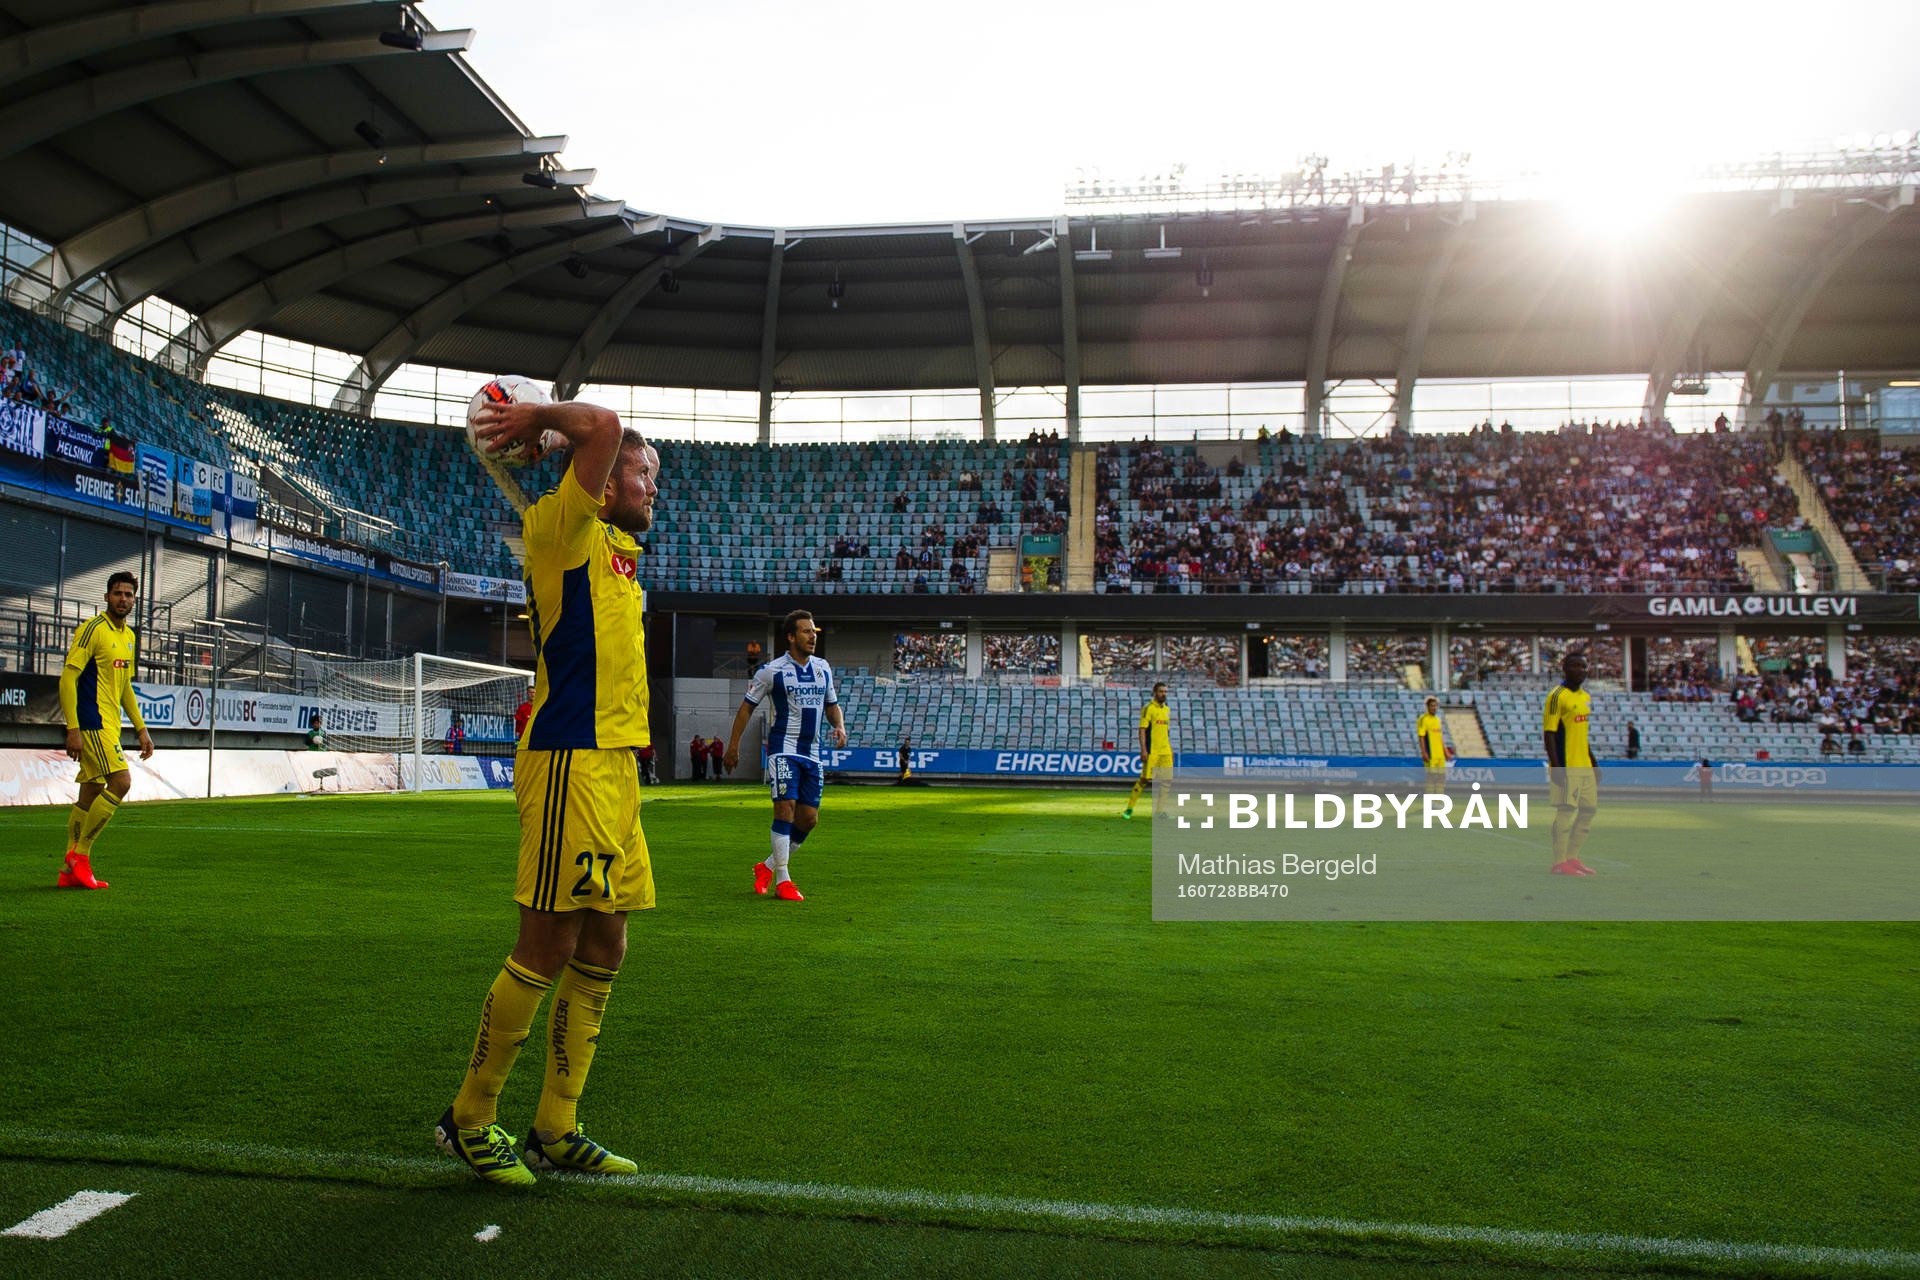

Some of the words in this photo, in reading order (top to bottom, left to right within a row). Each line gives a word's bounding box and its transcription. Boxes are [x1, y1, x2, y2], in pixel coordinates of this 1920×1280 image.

[57, 440, 93, 464] HELSINKI
[199, 467, 207, 485] C
[213, 472, 224, 491] FC
[75, 474, 115, 501] SVERIGE
[236, 480, 254, 499] HJK
[293, 538, 306, 553] oss
[306, 539, 321, 555] hela
[341, 549, 351, 563] till
[1648, 597, 1742, 616] GAMLA
[1768, 597, 1857, 616] ULLEVI
[0, 688, 26, 708] iNER
[786, 685, 825, 696] Prioritet
[460, 713, 506, 739] DEMIDEKK
[996, 752, 1144, 774] EHRENBORG
[1445, 767, 1494, 781] RASTA
[1723, 762, 1827, 786] Kappa
[571, 850, 616, 898] 27
[553, 998, 569, 1077] DESTAMATIC
